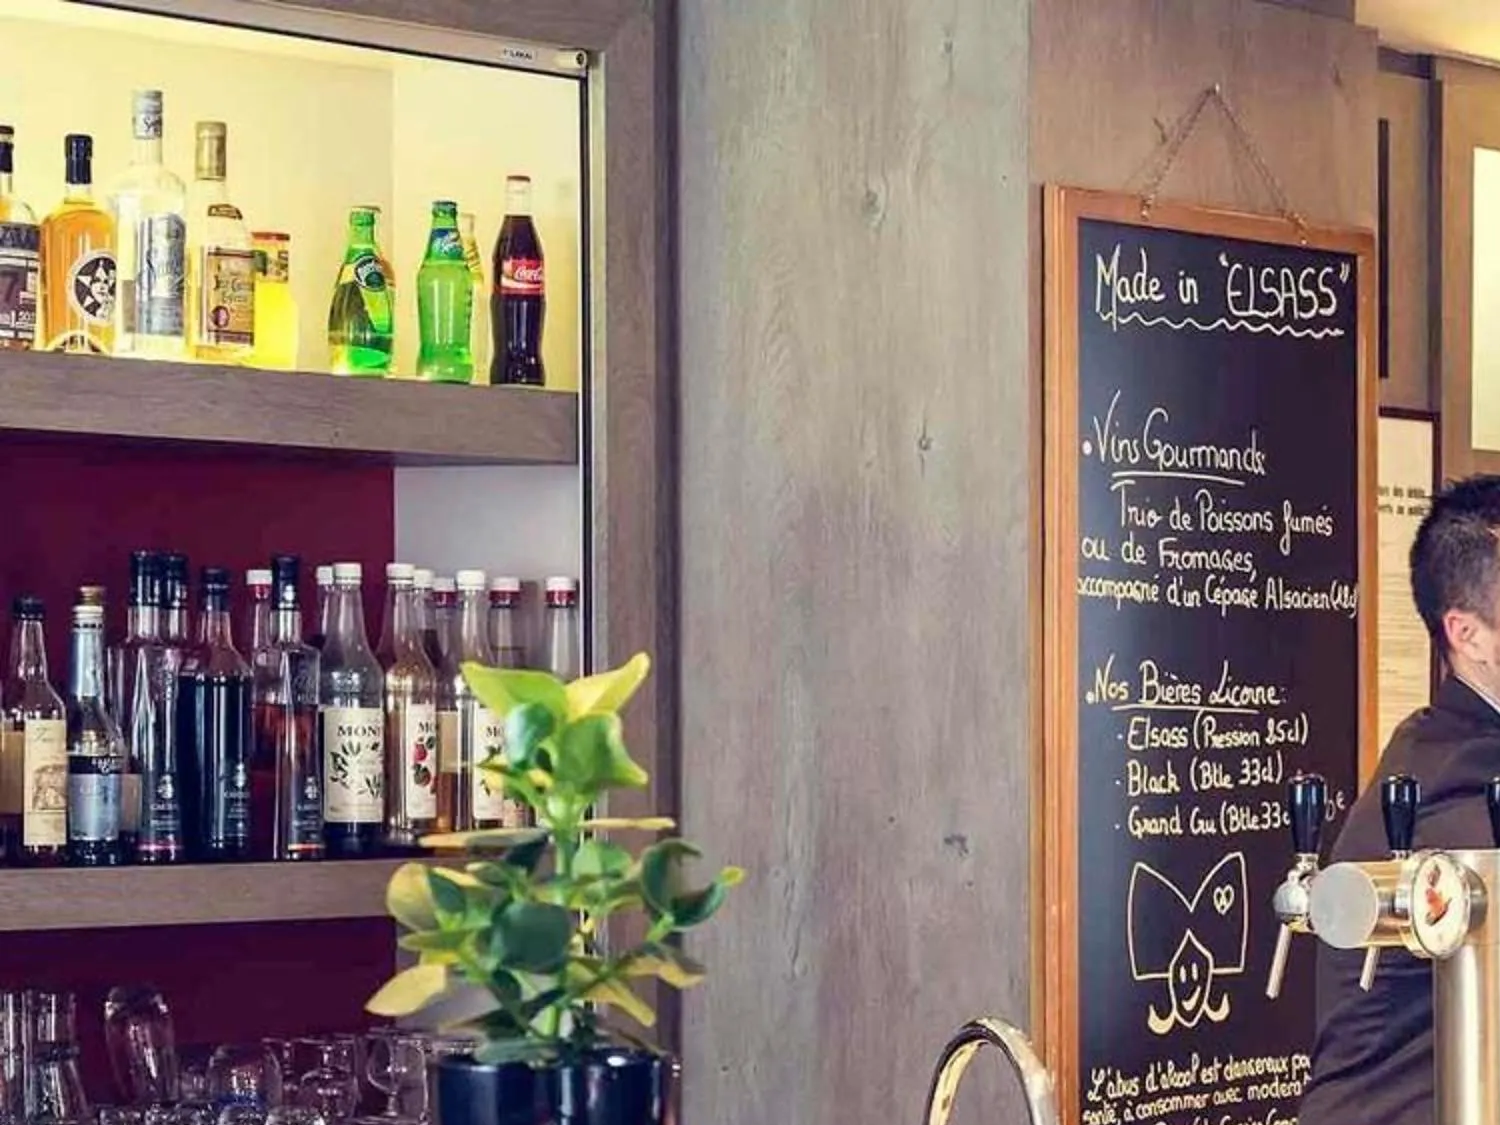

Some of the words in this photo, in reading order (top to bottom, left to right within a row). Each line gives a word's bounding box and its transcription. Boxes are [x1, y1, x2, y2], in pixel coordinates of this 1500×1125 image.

[1096, 244, 1165, 332] Made
[1179, 270, 1199, 304] in
[1094, 389, 1141, 464] Vins
[1169, 496, 1193, 531] de
[1195, 488, 1273, 532] Poissons
[1081, 536, 1110, 562] ou
[1121, 531, 1147, 565] de
[1094, 653, 1129, 702] Nos
[1138, 659, 1201, 706] Bières
[1127, 716, 1188, 751] Elsass
[1127, 759, 1180, 797] Black
[1127, 804, 1182, 840] Grand
